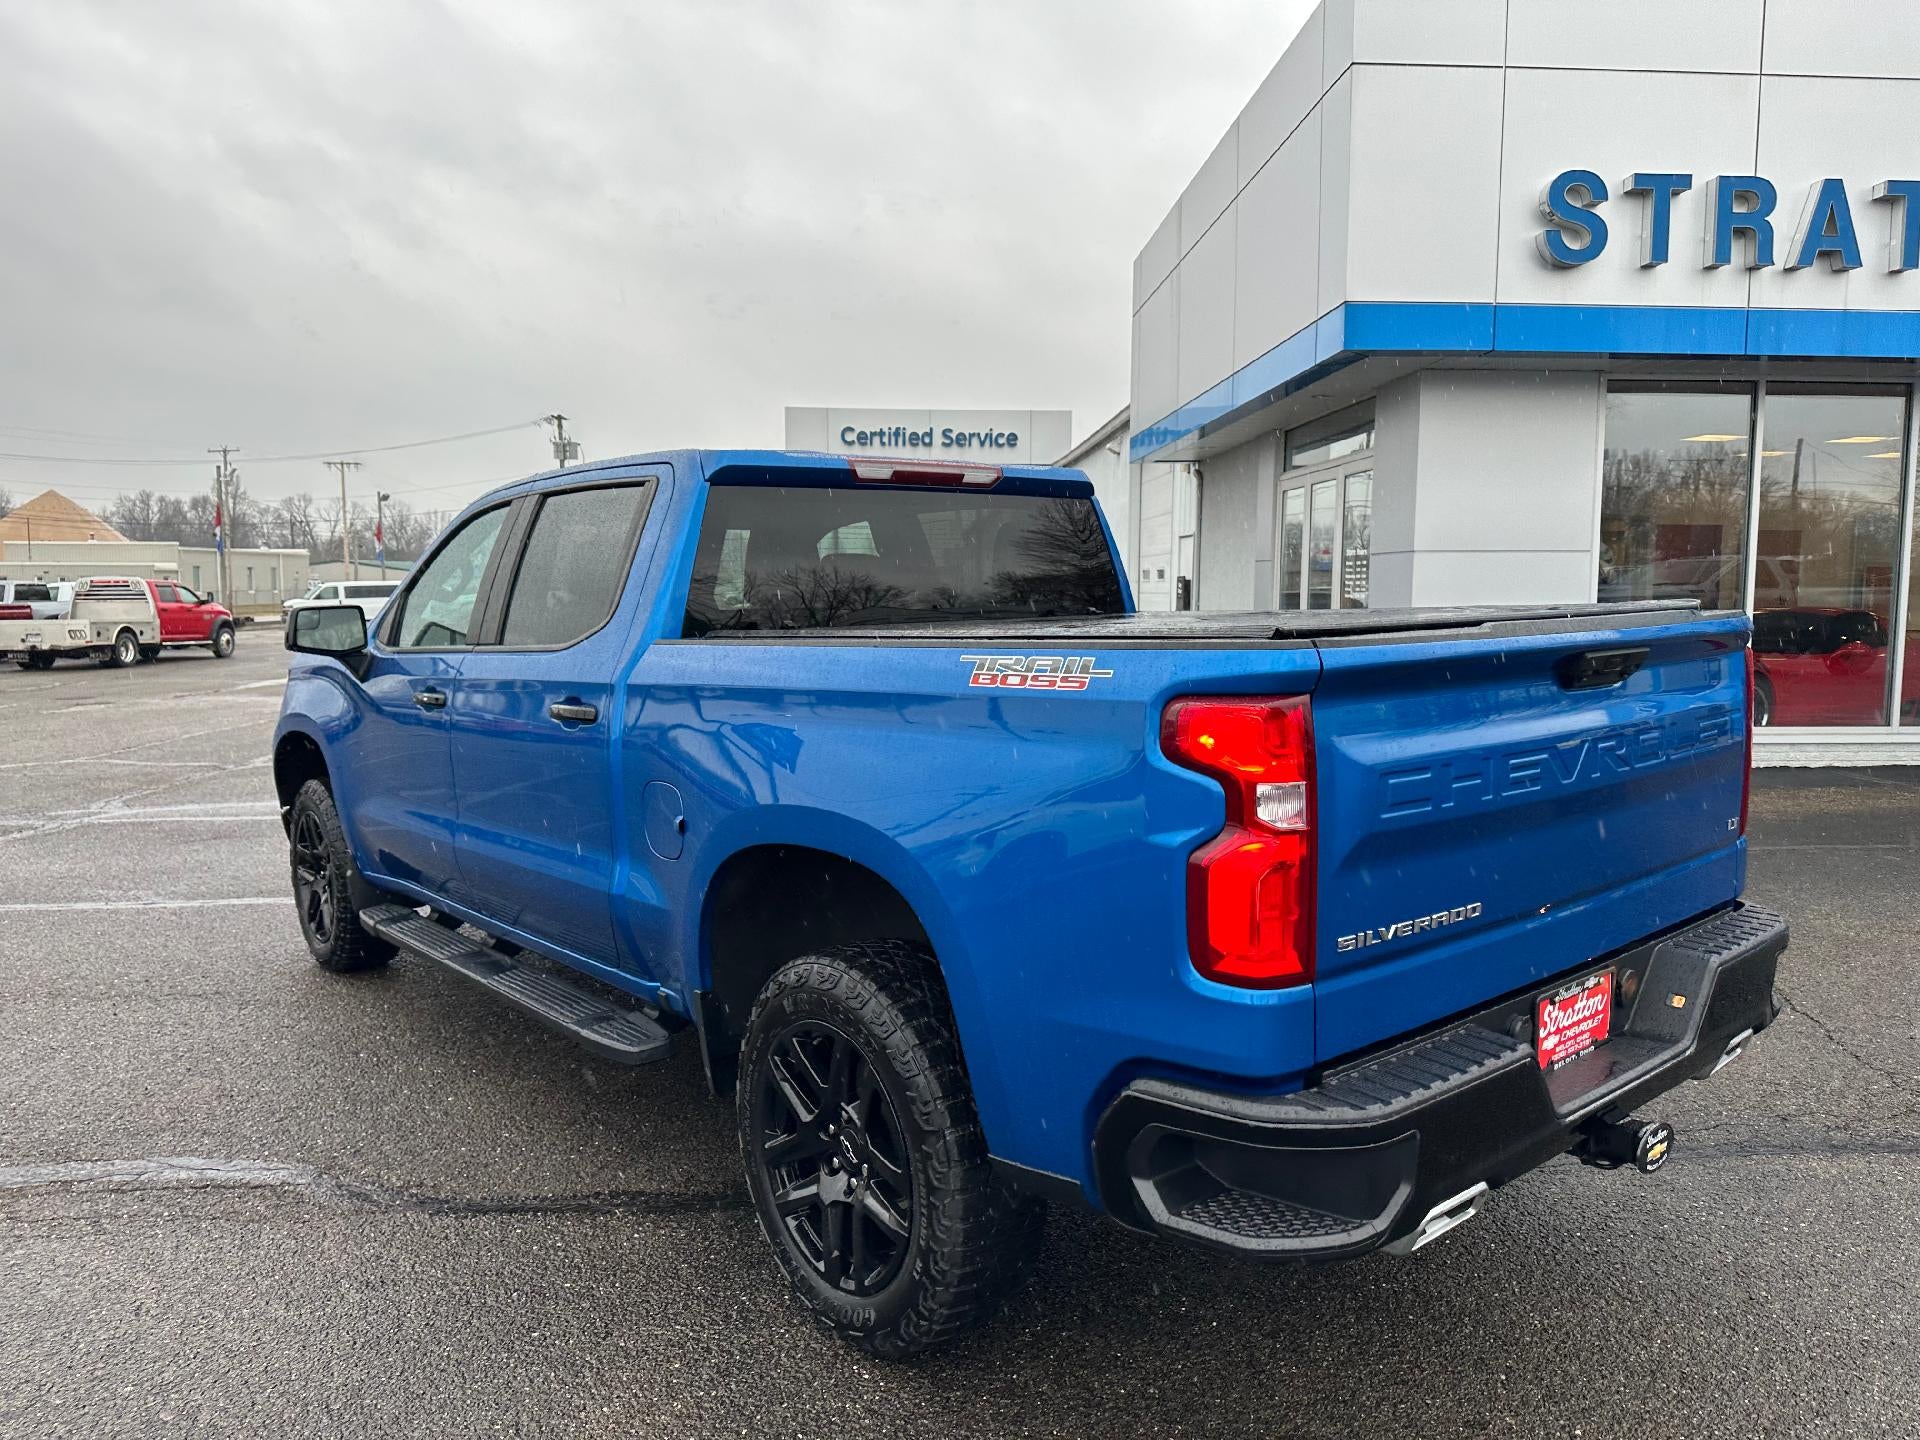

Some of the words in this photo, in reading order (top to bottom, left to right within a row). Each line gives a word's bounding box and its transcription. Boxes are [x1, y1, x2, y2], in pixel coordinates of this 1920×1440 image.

[840, 426, 933, 448] Certified
[941, 428, 1019, 449] Service
[960, 655, 1114, 677] TRAIL
[969, 672, 1090, 690] BOSS
[1337, 902, 1482, 953] SILVERADO
[1540, 990, 1607, 1038] Stratton
[1560, 1013, 1604, 1042] CHEVROLET
[1579, 1045, 1595, 1059] OHIO
